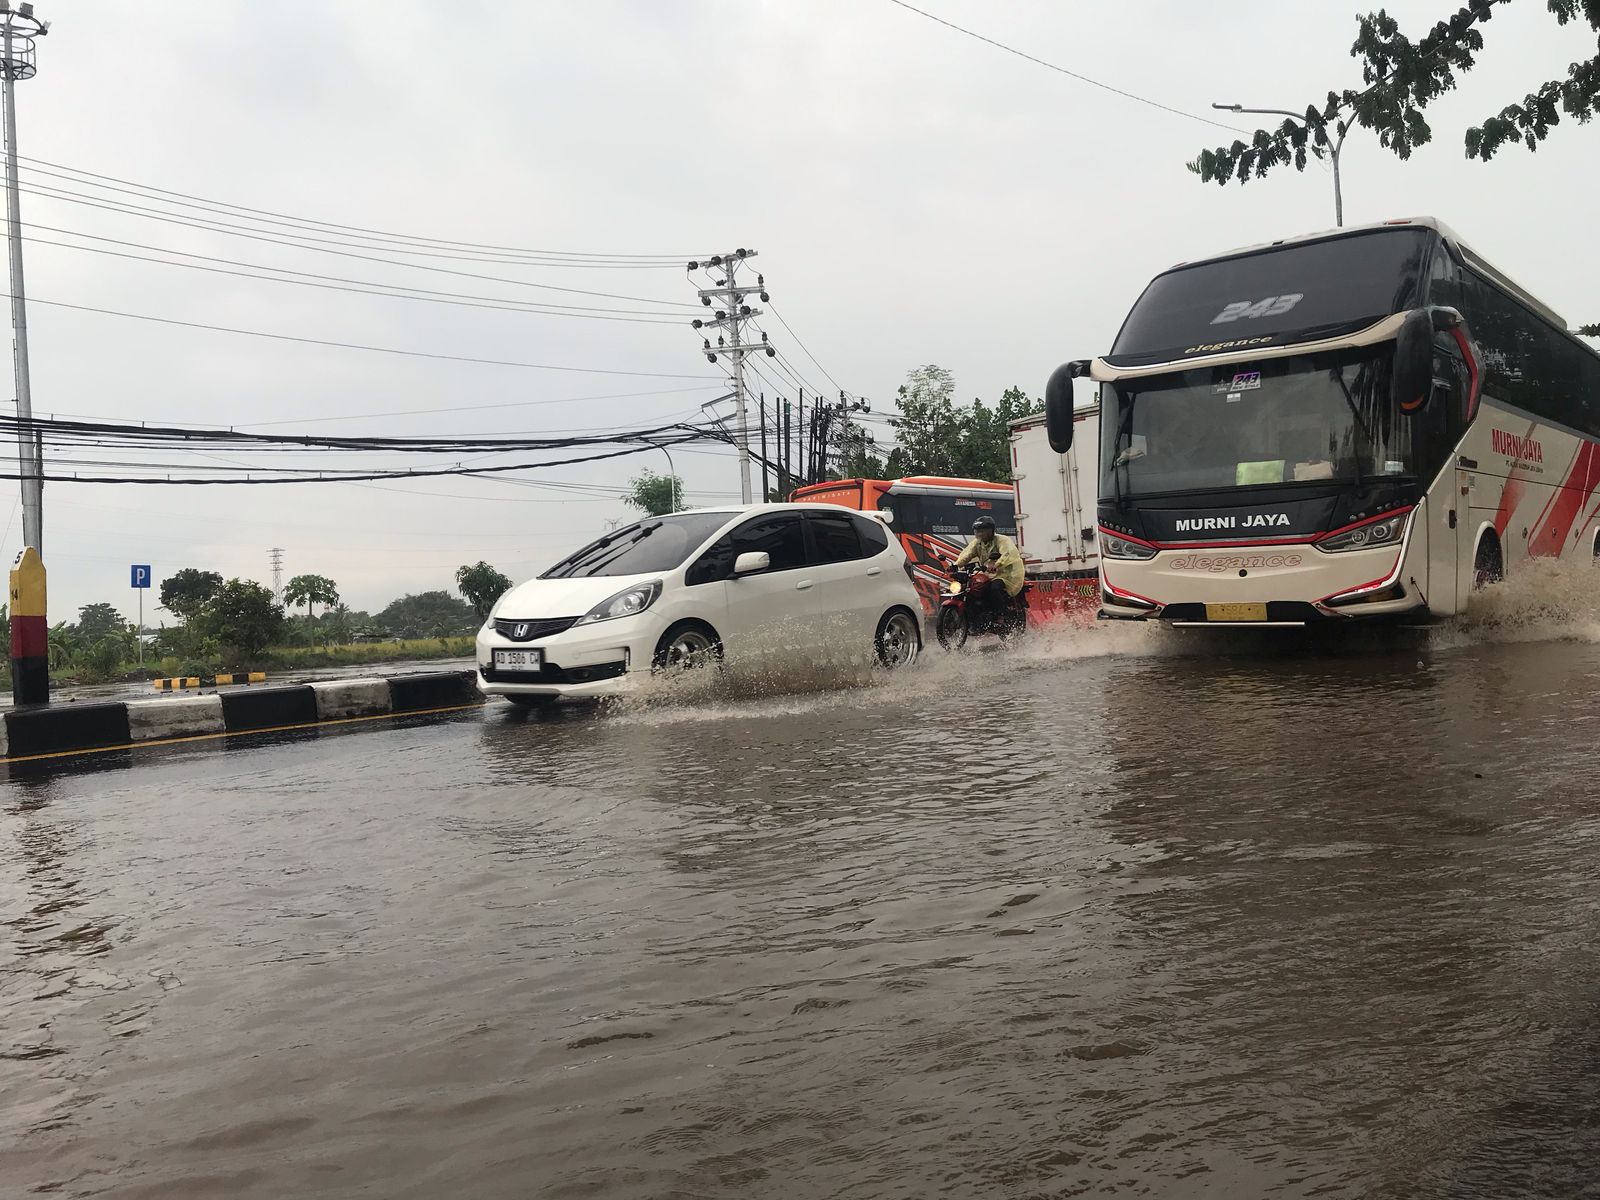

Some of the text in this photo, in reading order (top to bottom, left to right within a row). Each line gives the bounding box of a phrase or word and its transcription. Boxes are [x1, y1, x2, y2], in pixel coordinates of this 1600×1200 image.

[1209, 293, 1304, 325] 243
[1184, 336, 1273, 354] elegance
[1234, 373, 1260, 386] 243
[1491, 428, 1543, 464] MURNI JAYA
[1176, 513, 1291, 532] MURNI JAYA
[1170, 554, 1302, 573] elegance
[137, 568, 145, 585] P
